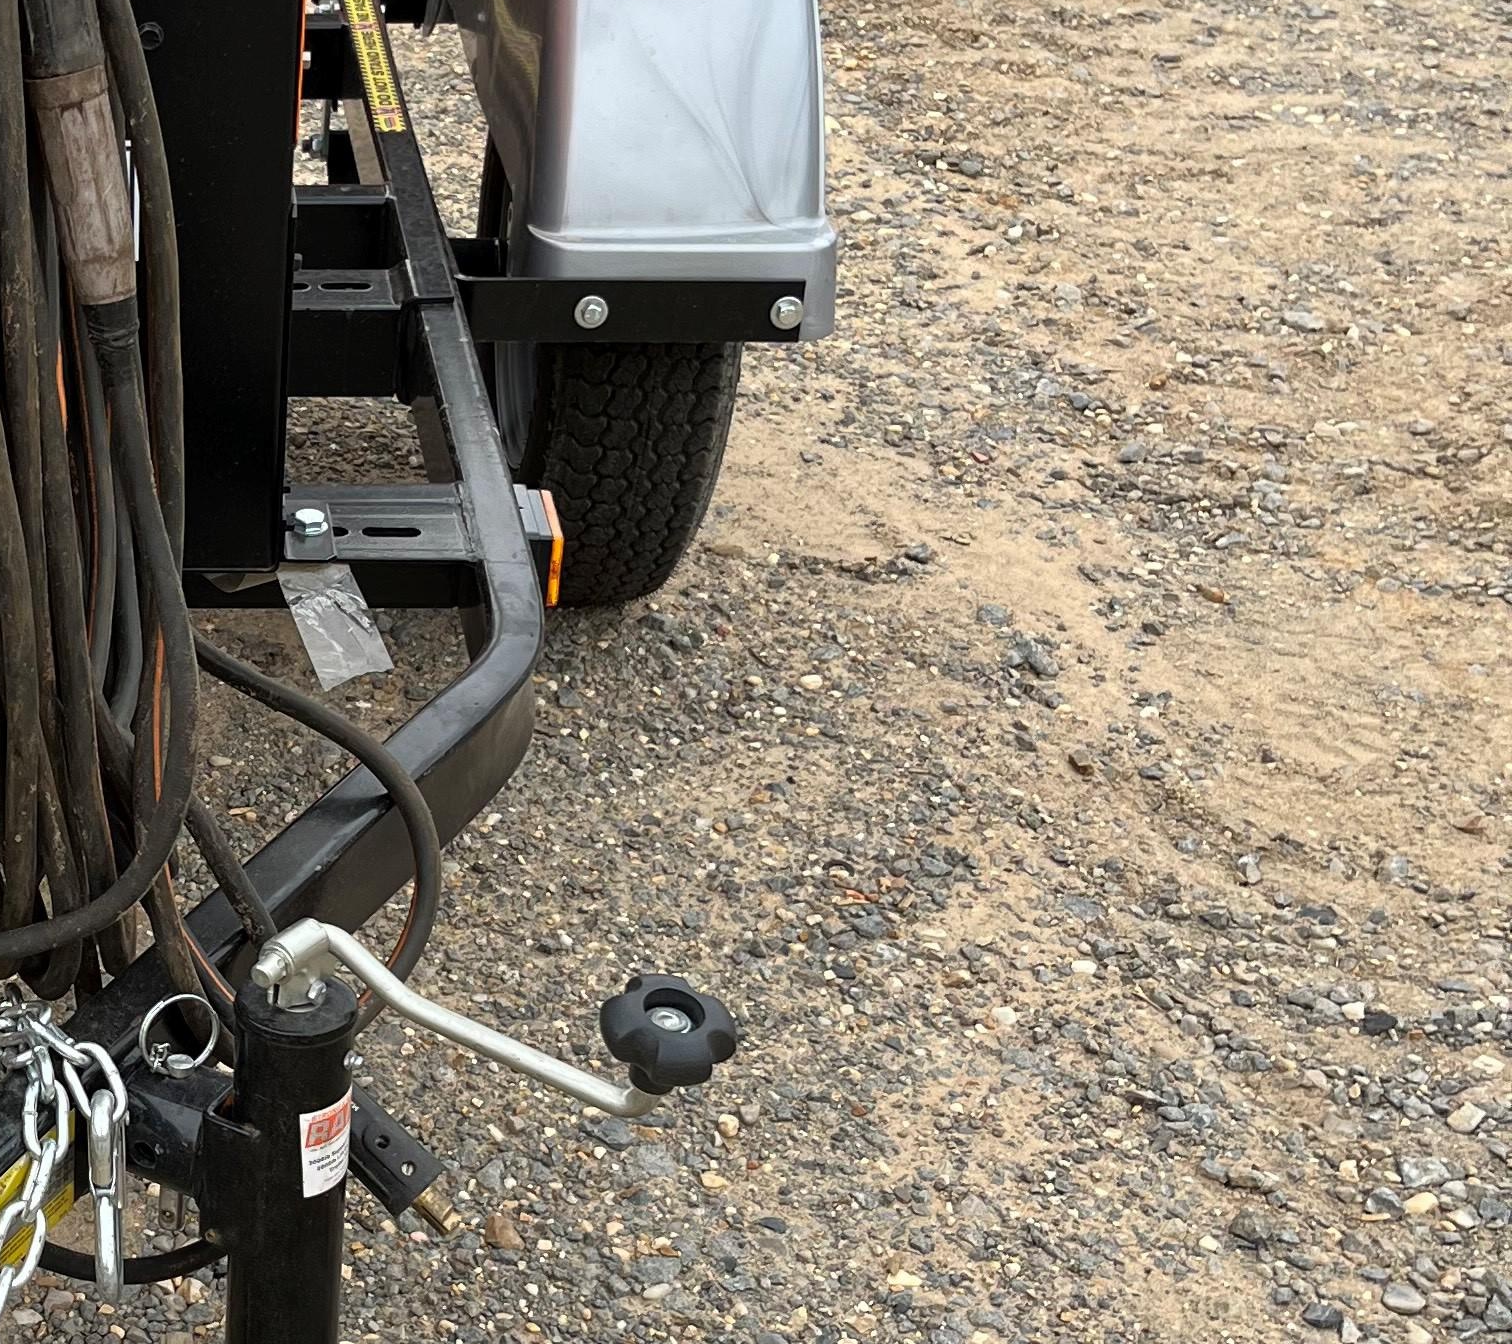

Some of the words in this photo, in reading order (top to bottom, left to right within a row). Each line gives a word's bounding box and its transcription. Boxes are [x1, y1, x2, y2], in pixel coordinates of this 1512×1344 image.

[367, 51, 385, 76] STAND
[372, 77, 389, 93] NOT
[376, 94, 393, 106] DO
